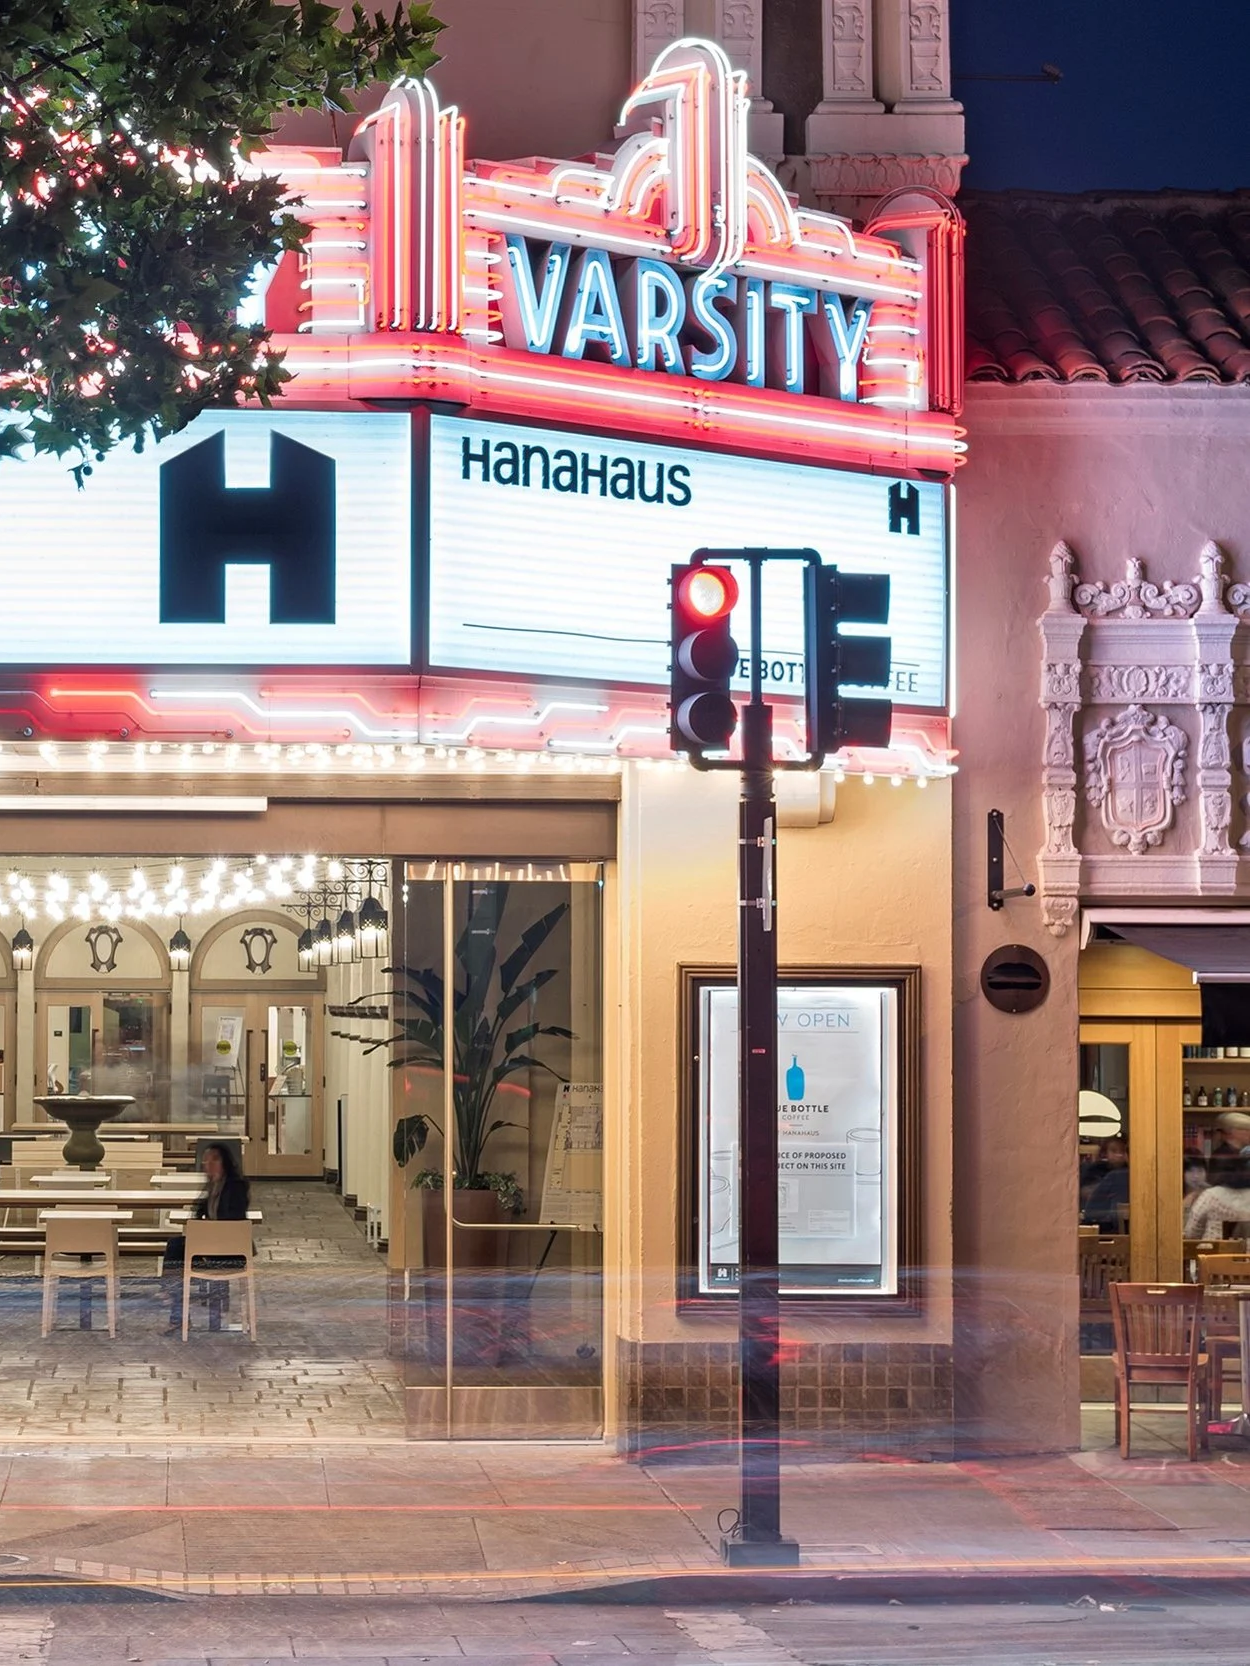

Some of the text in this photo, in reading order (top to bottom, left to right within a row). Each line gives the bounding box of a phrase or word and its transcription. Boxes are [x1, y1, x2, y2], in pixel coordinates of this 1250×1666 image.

[504, 233, 874, 402] VARSITY
[462, 437, 692, 506] HanaHaus
[160, 429, 336, 625] H
[797, 1013, 850, 1027] OPEN
[791, 1105, 829, 1113] BOTTLE
